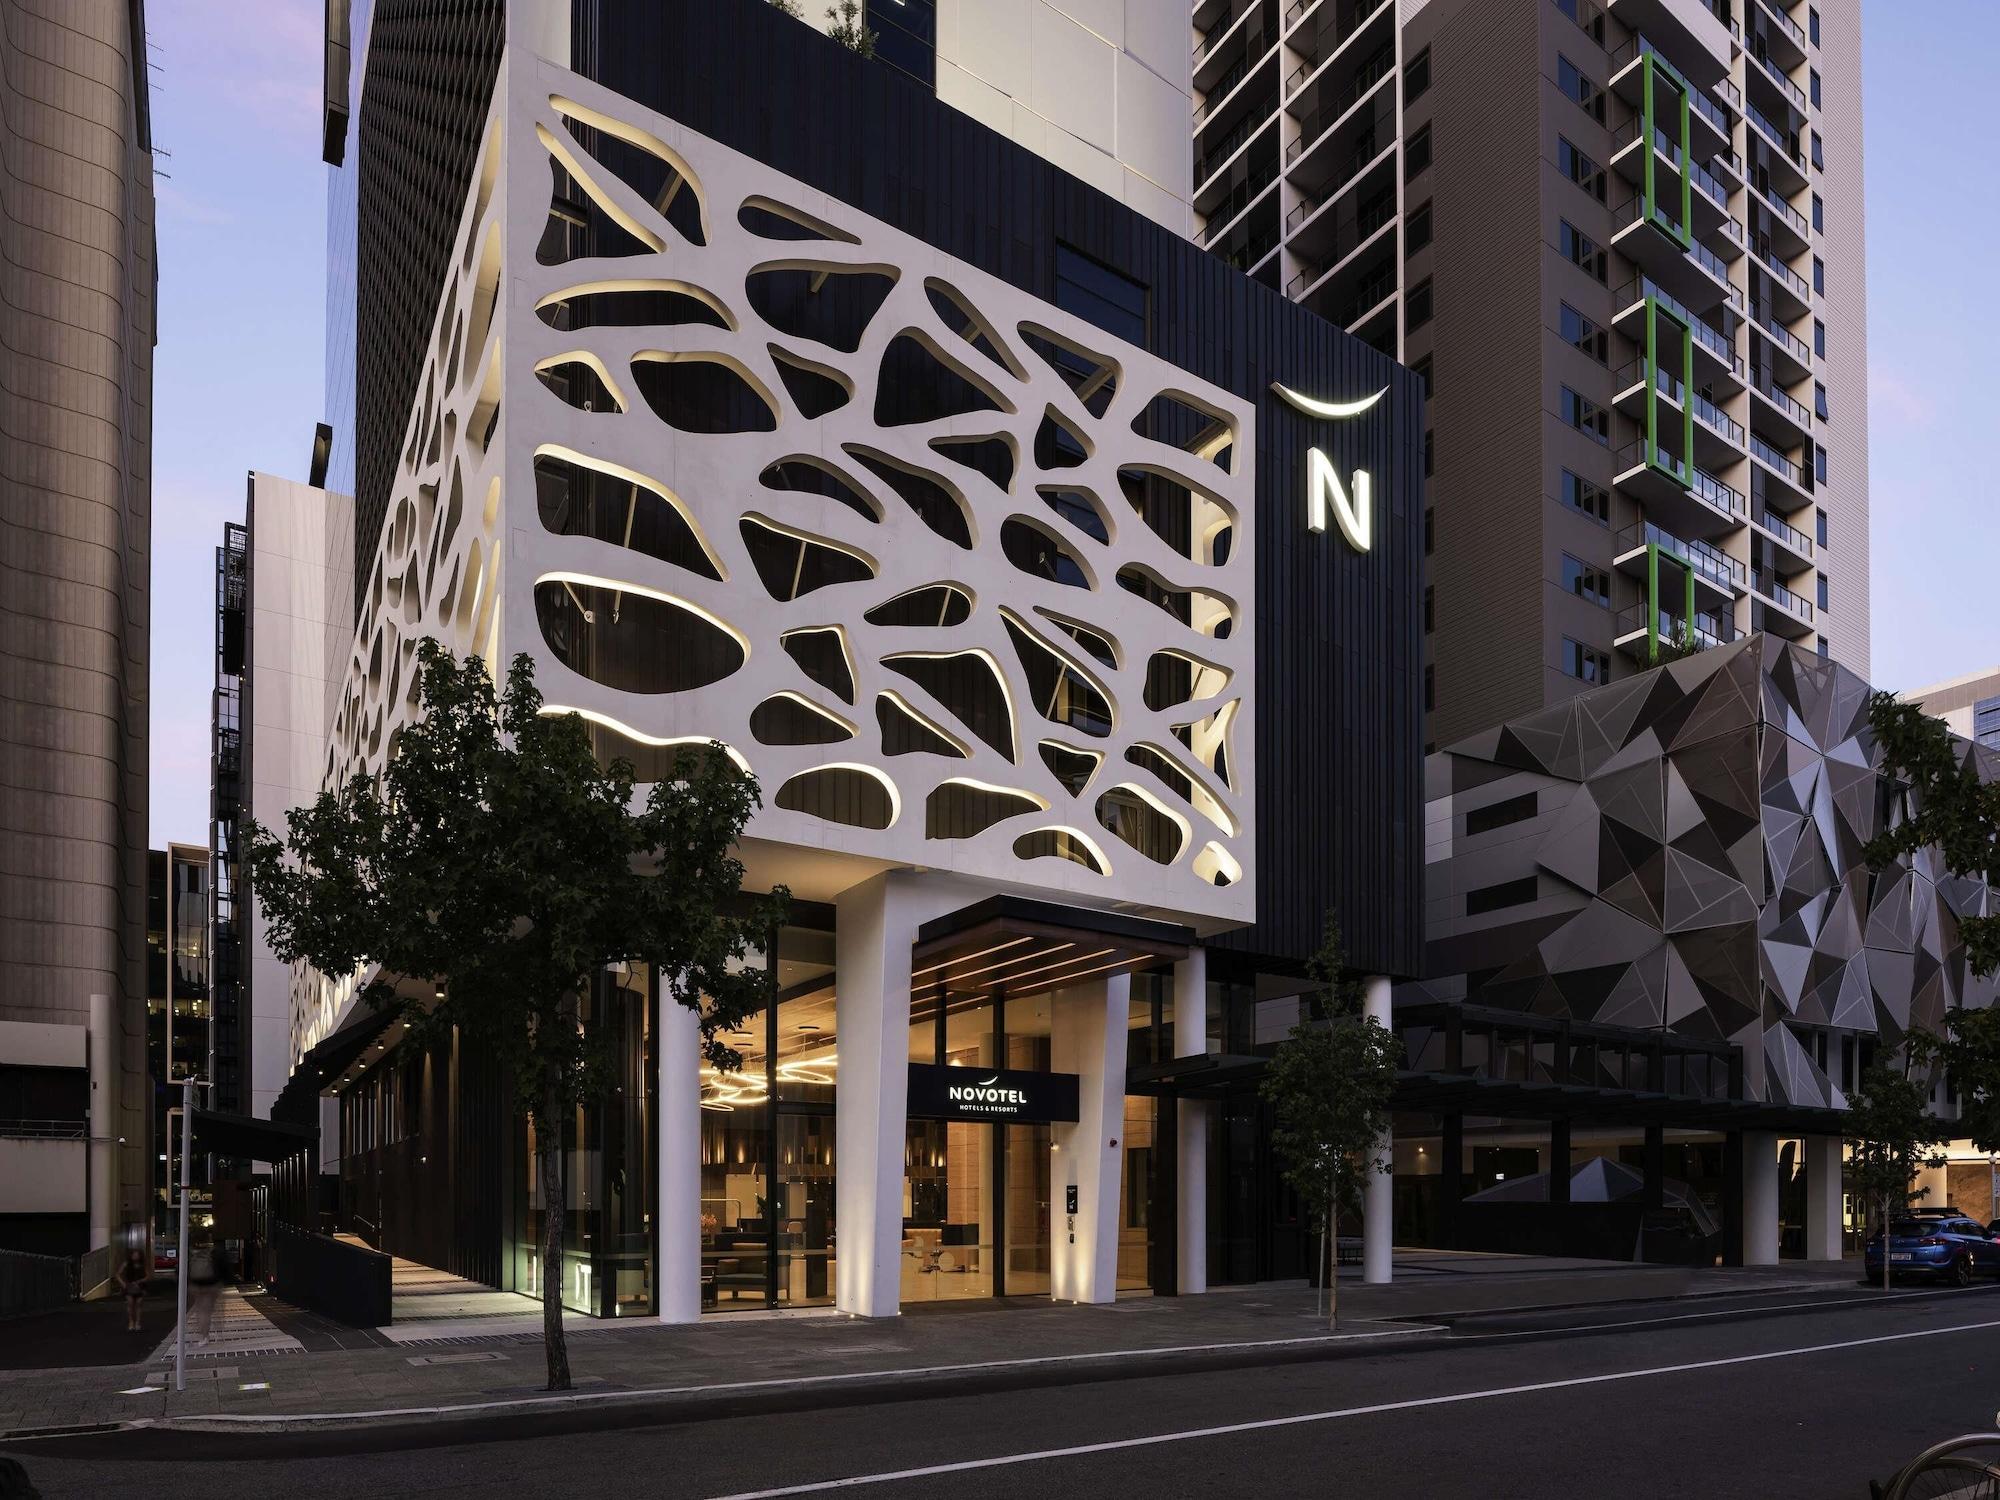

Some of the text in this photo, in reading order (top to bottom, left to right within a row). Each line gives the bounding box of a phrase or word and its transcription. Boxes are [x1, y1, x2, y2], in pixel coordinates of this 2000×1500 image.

[1307, 446, 1370, 552] N
[949, 1087, 1027, 1104] NOVOTEL
[959, 1104, 984, 1112] HOTELS
